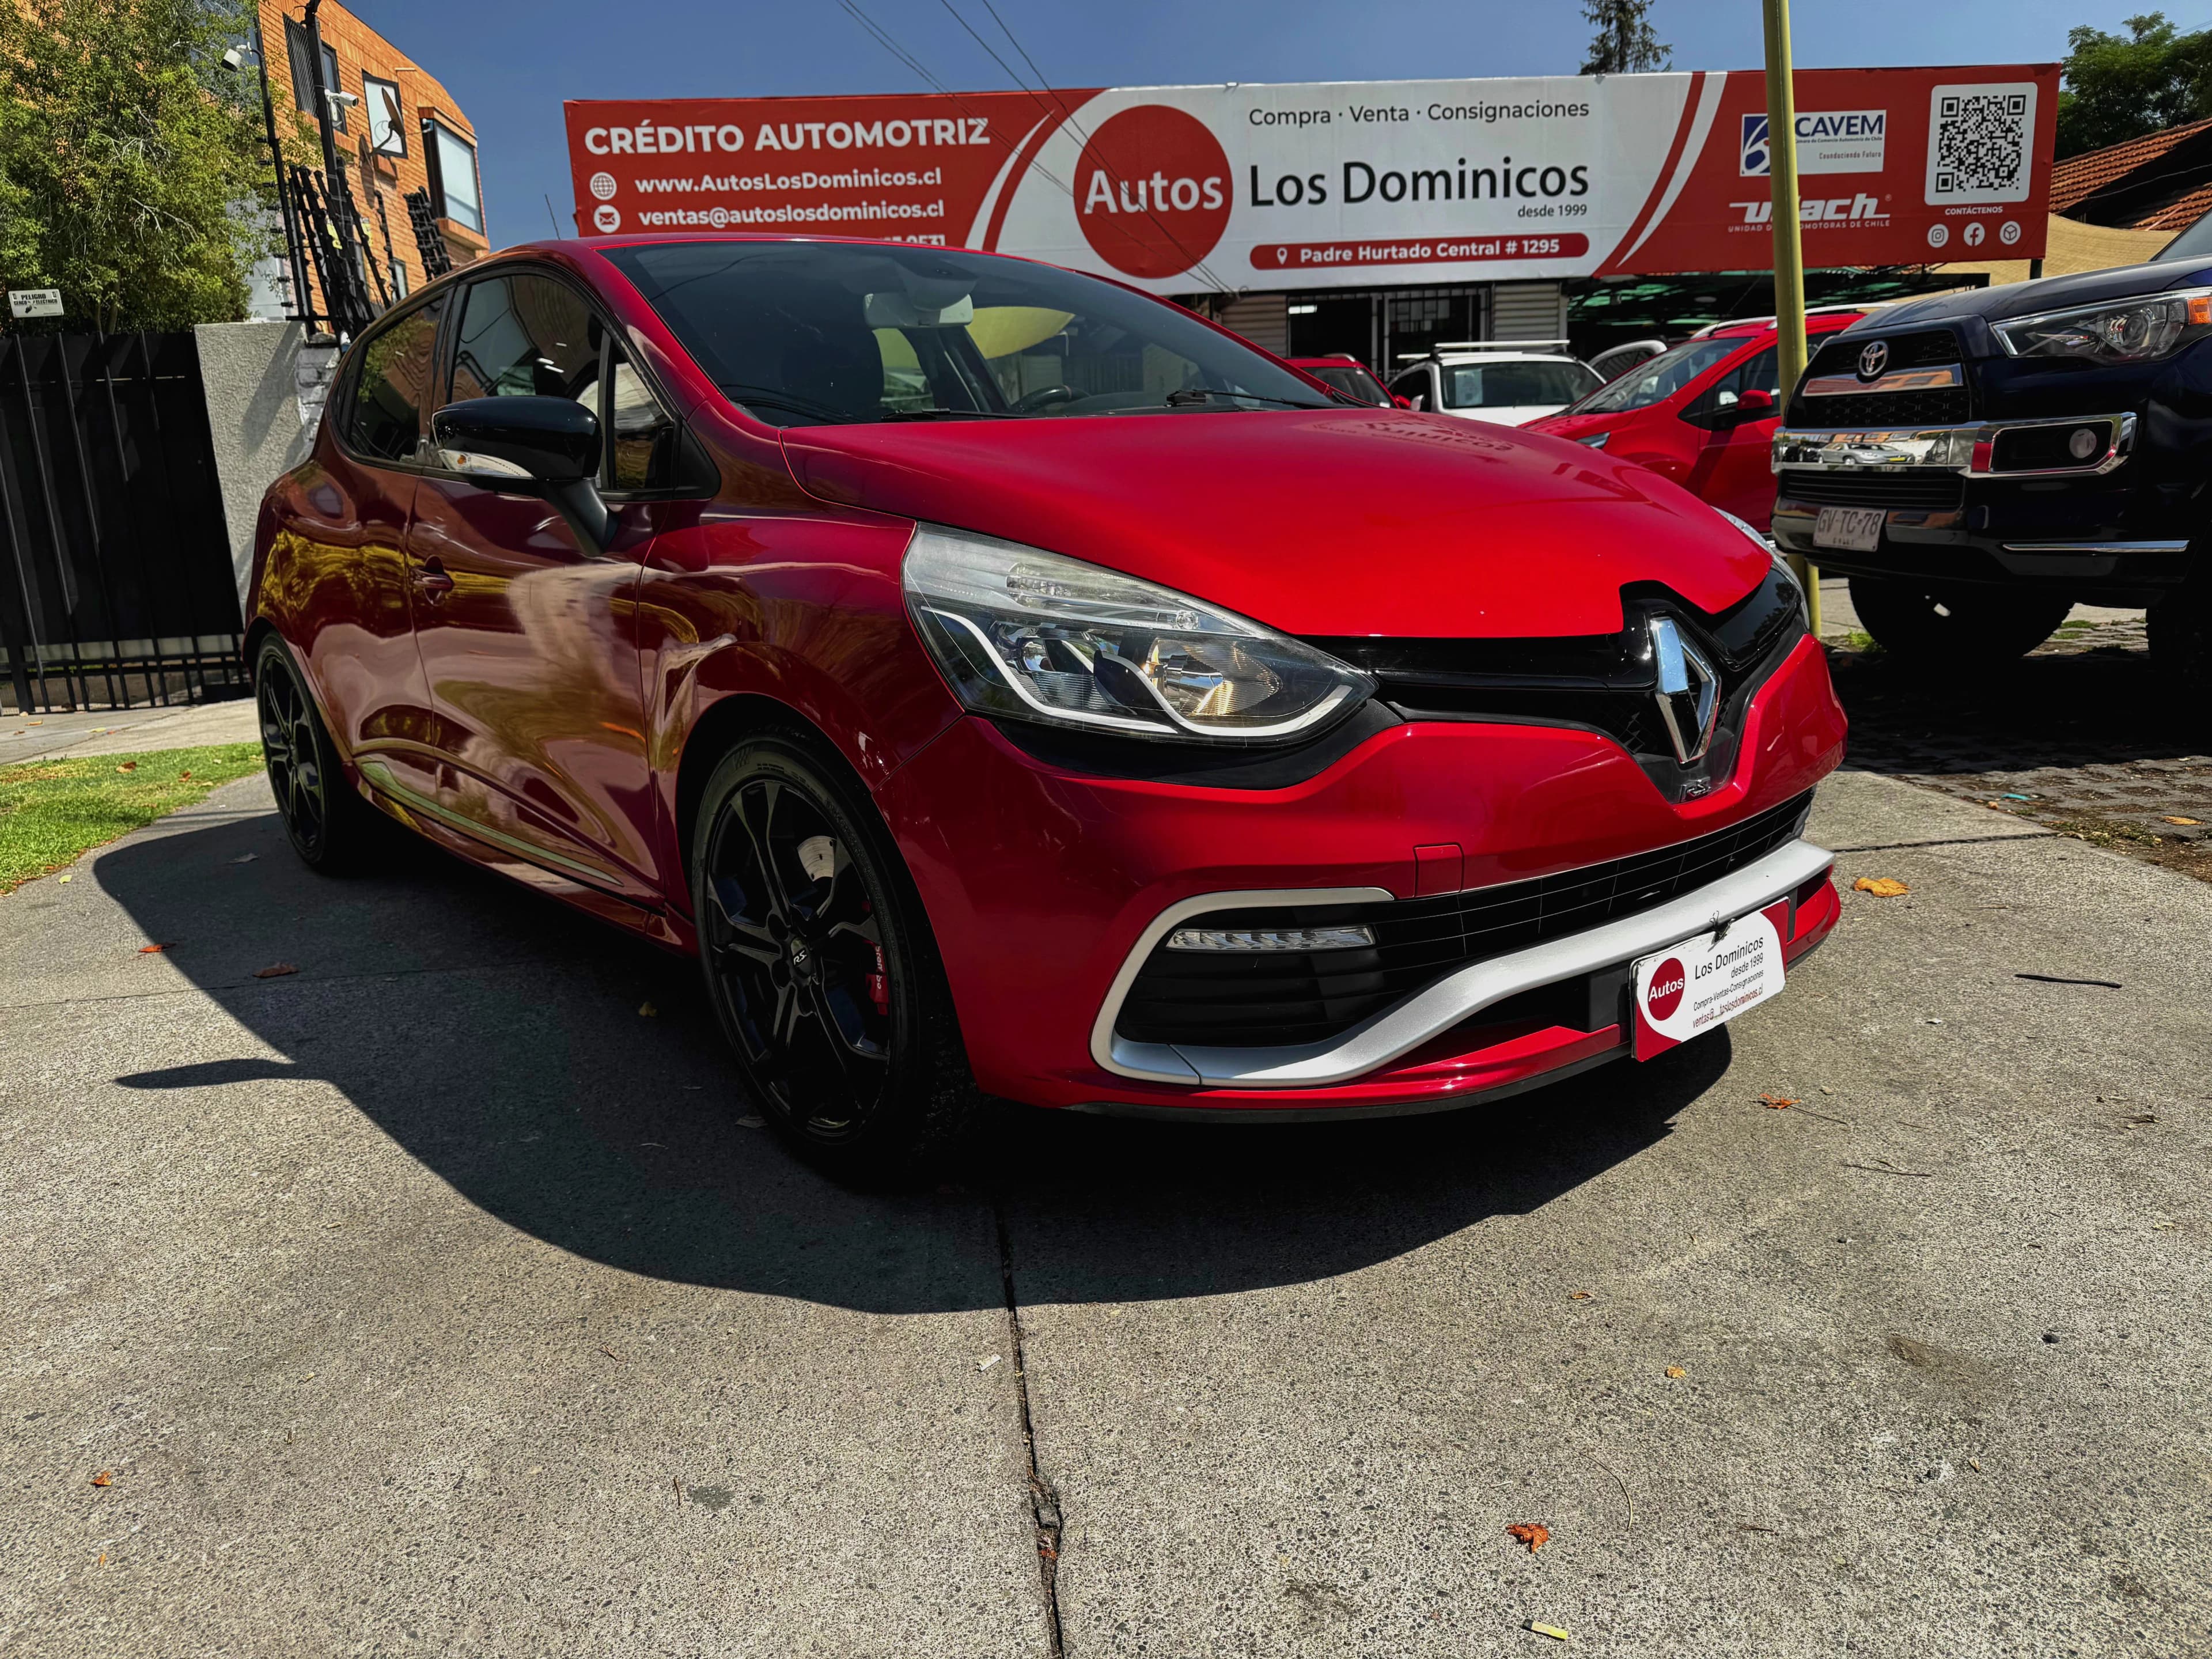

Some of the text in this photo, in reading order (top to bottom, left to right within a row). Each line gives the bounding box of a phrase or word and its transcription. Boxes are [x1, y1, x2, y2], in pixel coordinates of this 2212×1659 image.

[1249, 101, 1590, 128] Compra Venta Consignaciones
[1795, 114, 1884, 138] CAVEM
[585, 118, 990, 155] CRÉDITO AUTOMOTRIZ
[635, 167, 942, 194] www.AutosLosDominicos.cl
[1082, 169, 1224, 215] Autos
[1250, 156, 1589, 207] Los Dominicos
[638, 199, 944, 229] ventas@autoslosdominicos.cl
[1517, 204, 1588, 218] desde 1999
[1944, 206, 2003, 215] CONTÁCTENOS
[1728, 224, 1763, 233] UNIDAD
[1800, 221, 1847, 230] OMOTORAS
[1850, 219, 1861, 228] DE
[1300, 238, 1560, 263] Padre Hurtado Central # 1295
[1695, 937, 1764, 980] Los Dominicos
[1731, 952, 1763, 978] desde 1999
[1648, 977, 1684, 1002] Autos
